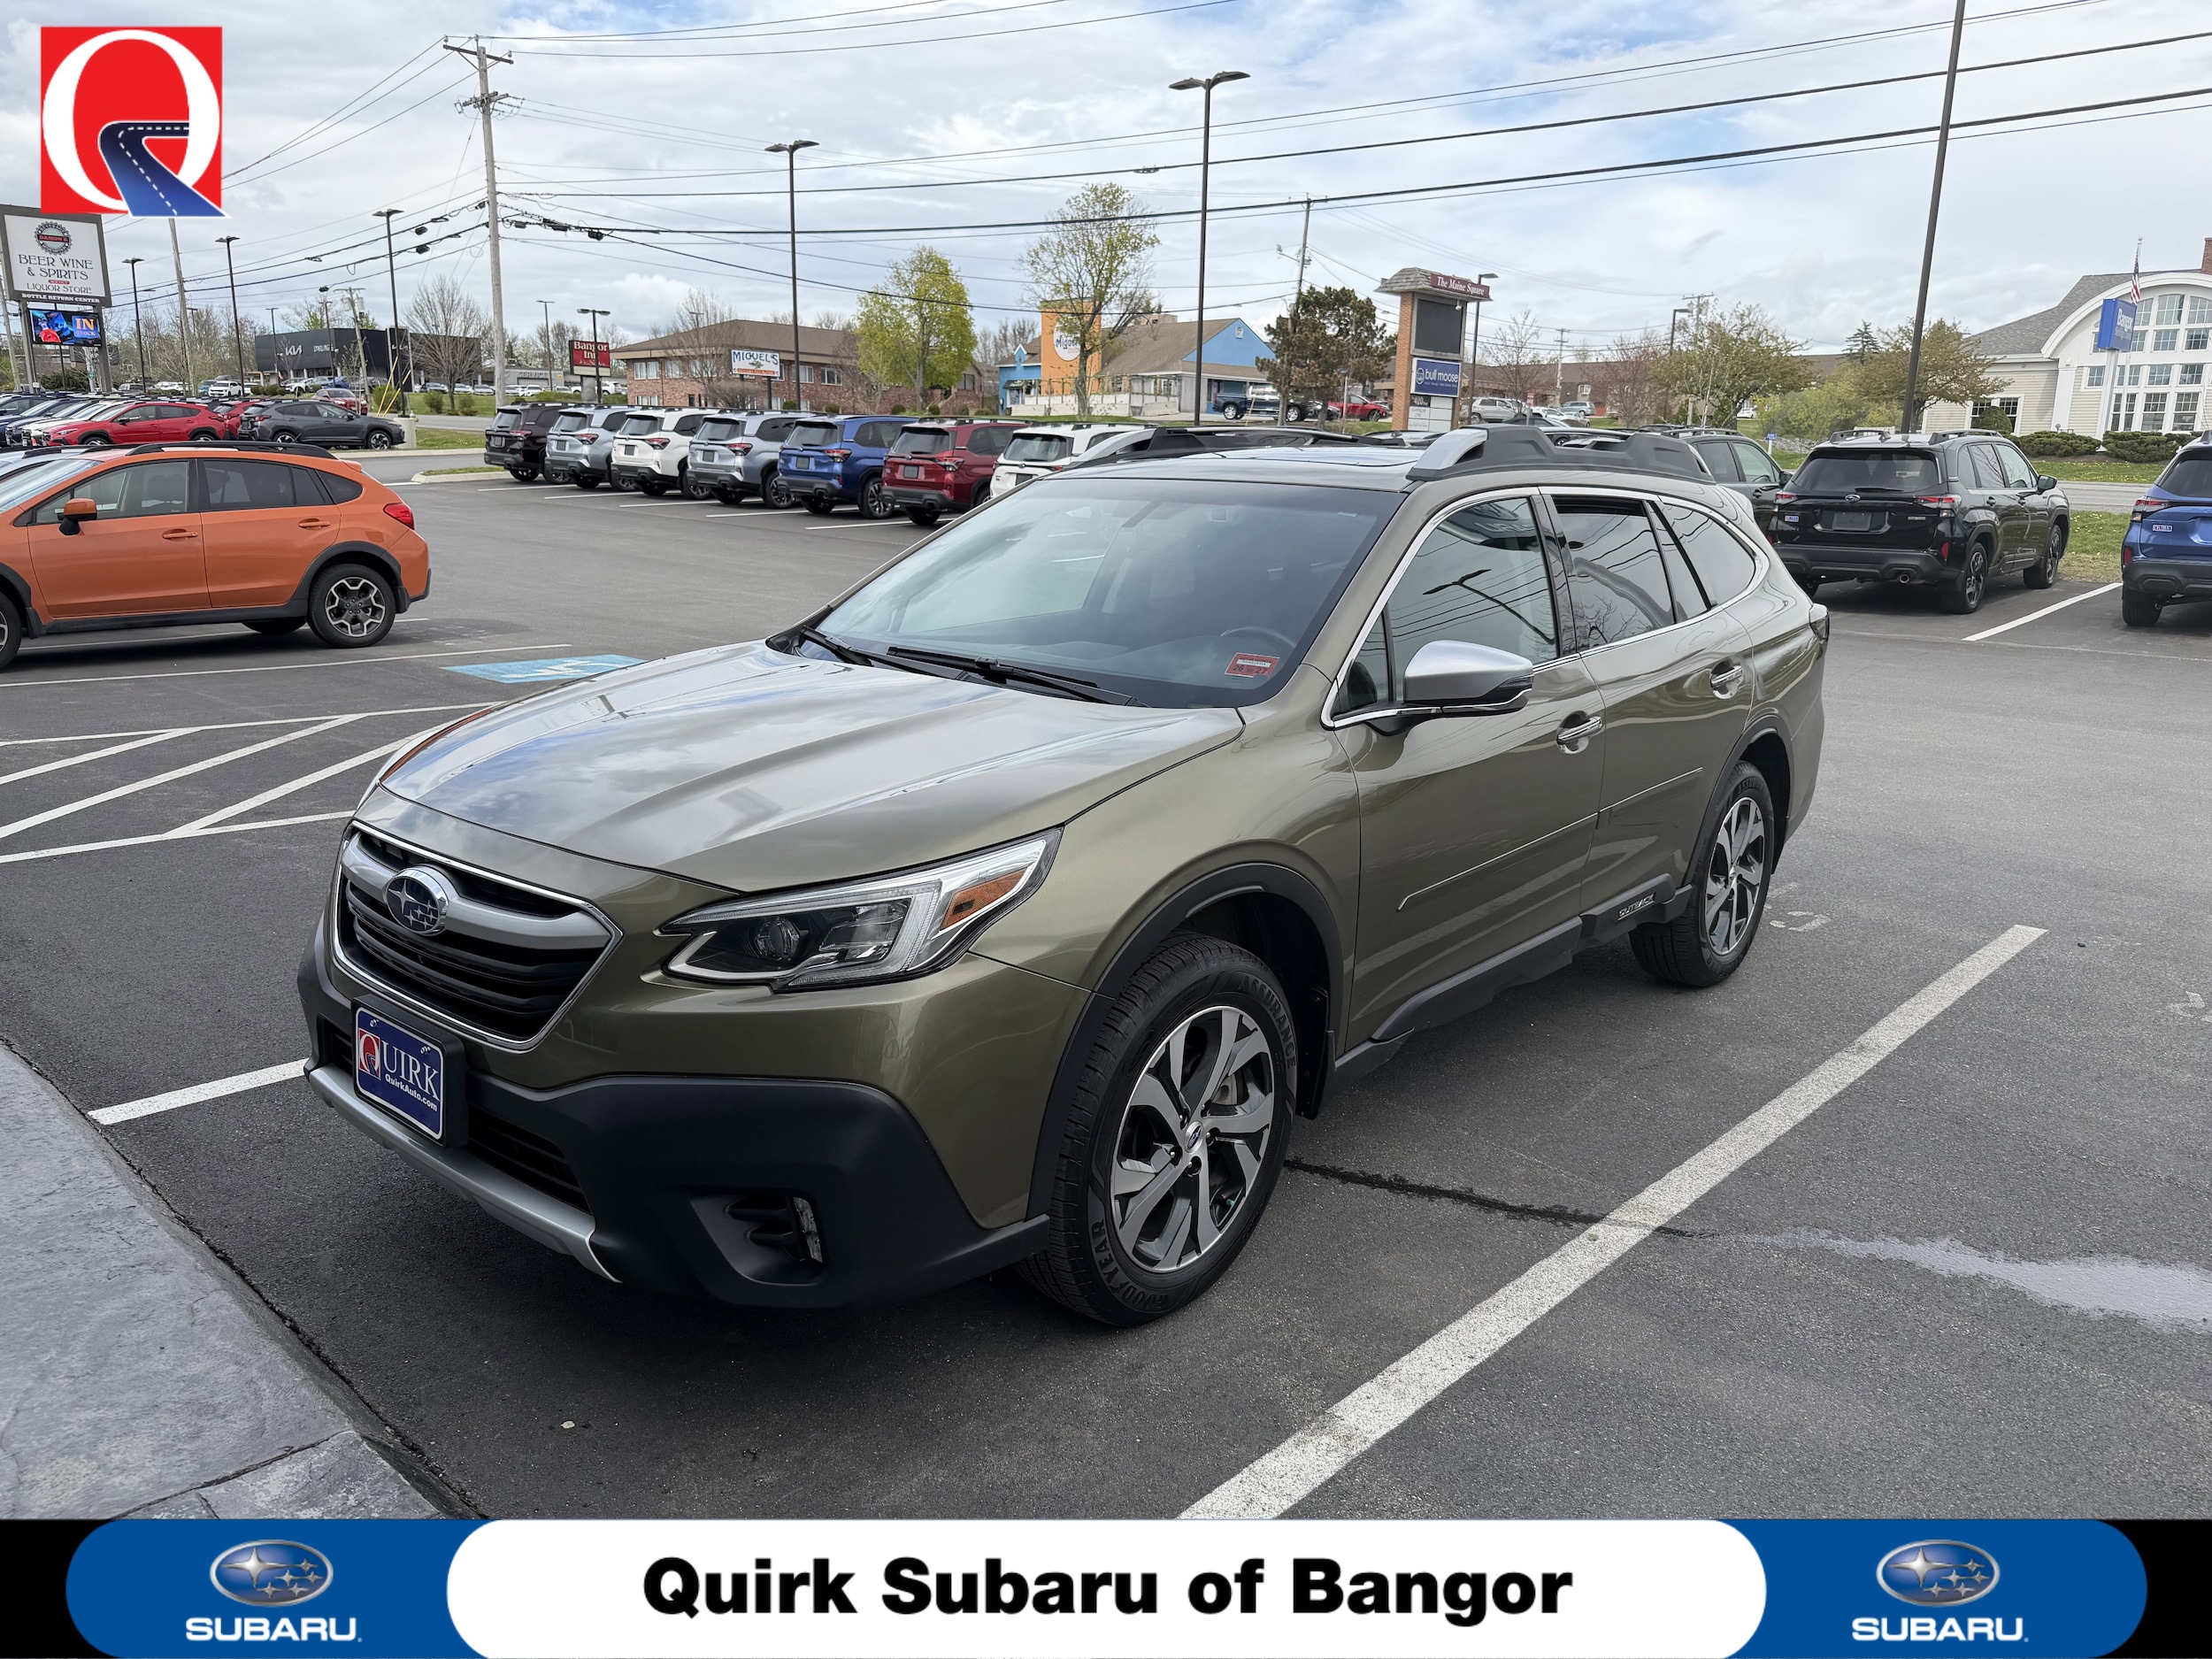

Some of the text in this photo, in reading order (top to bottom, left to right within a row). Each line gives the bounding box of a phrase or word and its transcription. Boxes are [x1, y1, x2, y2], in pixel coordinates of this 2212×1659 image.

[19, 254, 94, 270] BEER WINE
[27, 267, 88, 280] & SPIRITS
[27, 283, 60, 292] LIQUOR
[1437, 276, 1485, 295] The Maine Square
[76, 319, 94, 330] IN
[733, 351, 779, 365] MIGUEL'S
[1425, 369, 1458, 383] bull moose
[358, 1033, 441, 1102] QUIRK
[385, 1073, 437, 1111] QuirkAuto.com
